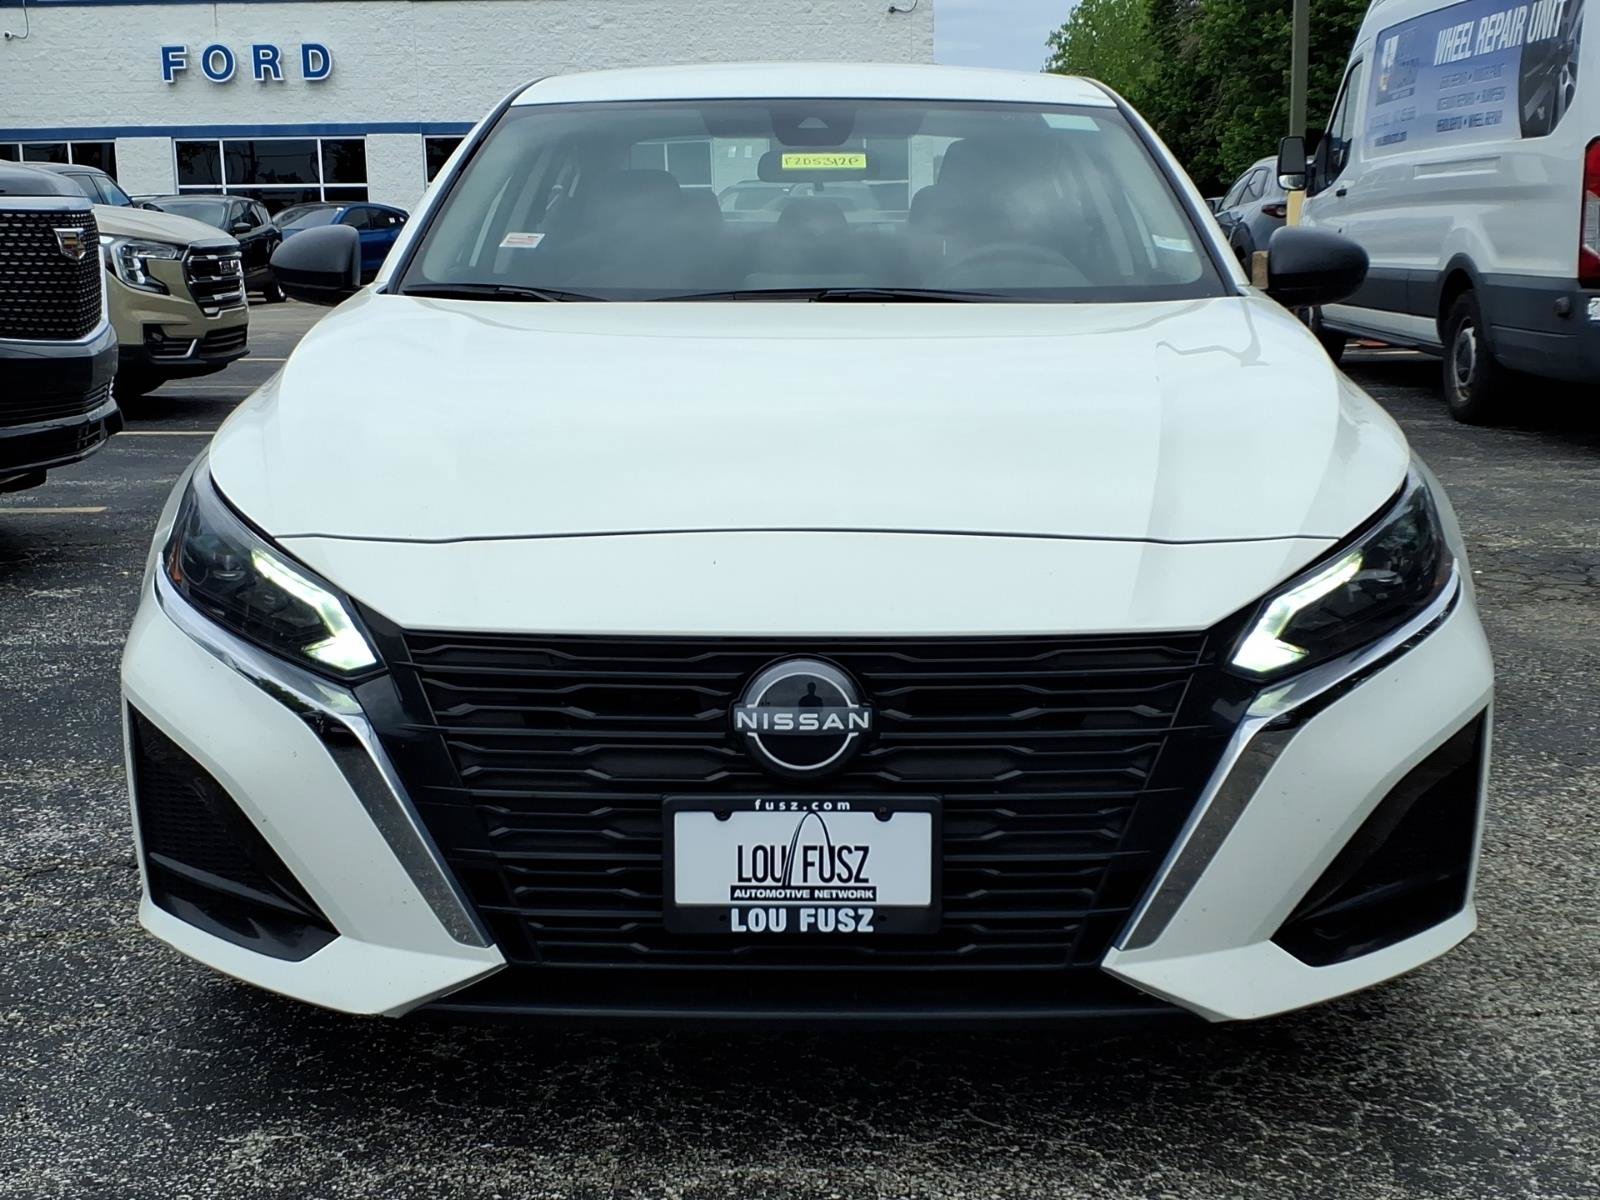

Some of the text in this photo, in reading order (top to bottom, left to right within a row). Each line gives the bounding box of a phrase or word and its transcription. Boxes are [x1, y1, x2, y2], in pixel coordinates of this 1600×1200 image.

[1433, 0, 1567, 66] WHEEL REPAIR UNIT
[161, 43, 332, 83] FORD
[736, 711, 869, 731] NISSAN
[754, 799, 851, 811] fusz.com
[737, 844, 870, 884] LOU FUSZ
[733, 888, 874, 899] AUTOMOTIVE NETWORK
[731, 908, 875, 933] LOU FUSZ
